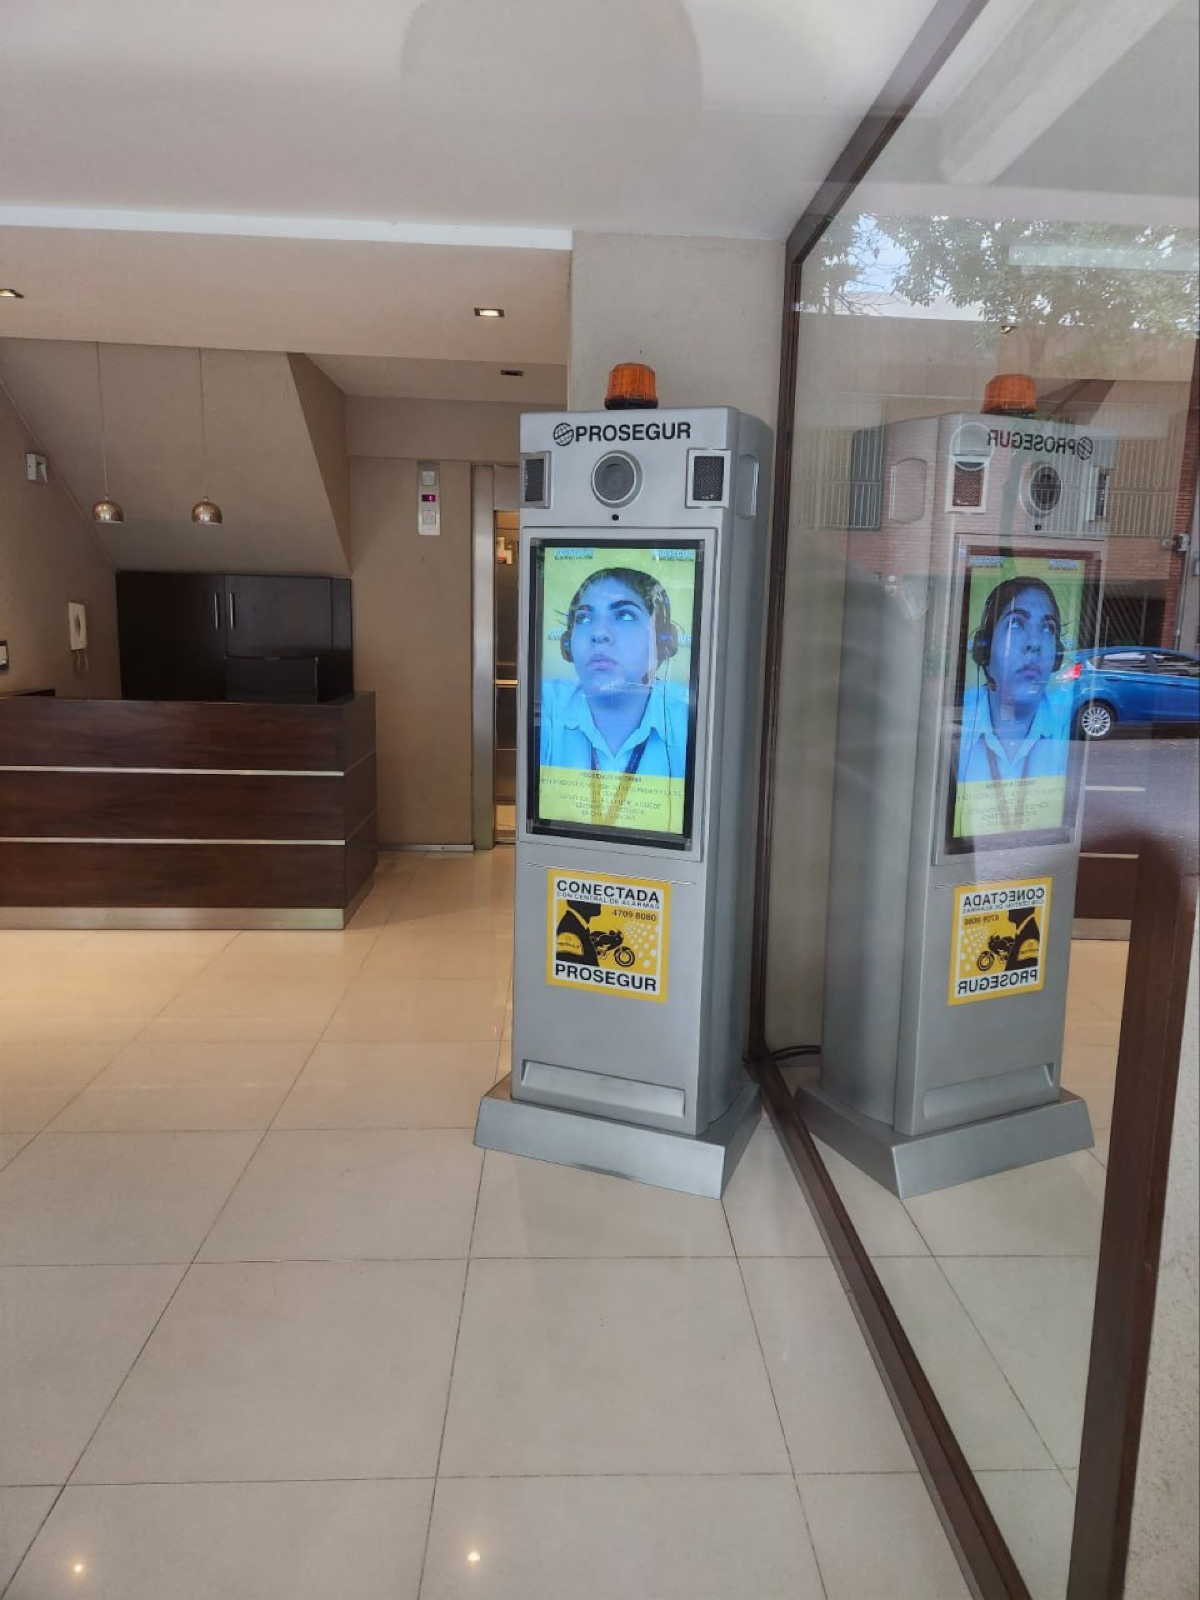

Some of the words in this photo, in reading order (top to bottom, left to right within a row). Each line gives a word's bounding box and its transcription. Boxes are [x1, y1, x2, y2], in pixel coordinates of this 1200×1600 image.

[575, 422, 691, 442] PROSEGUR
[556, 880, 660, 903] CONECTADA
[555, 963, 657, 991] PROSEGUR
